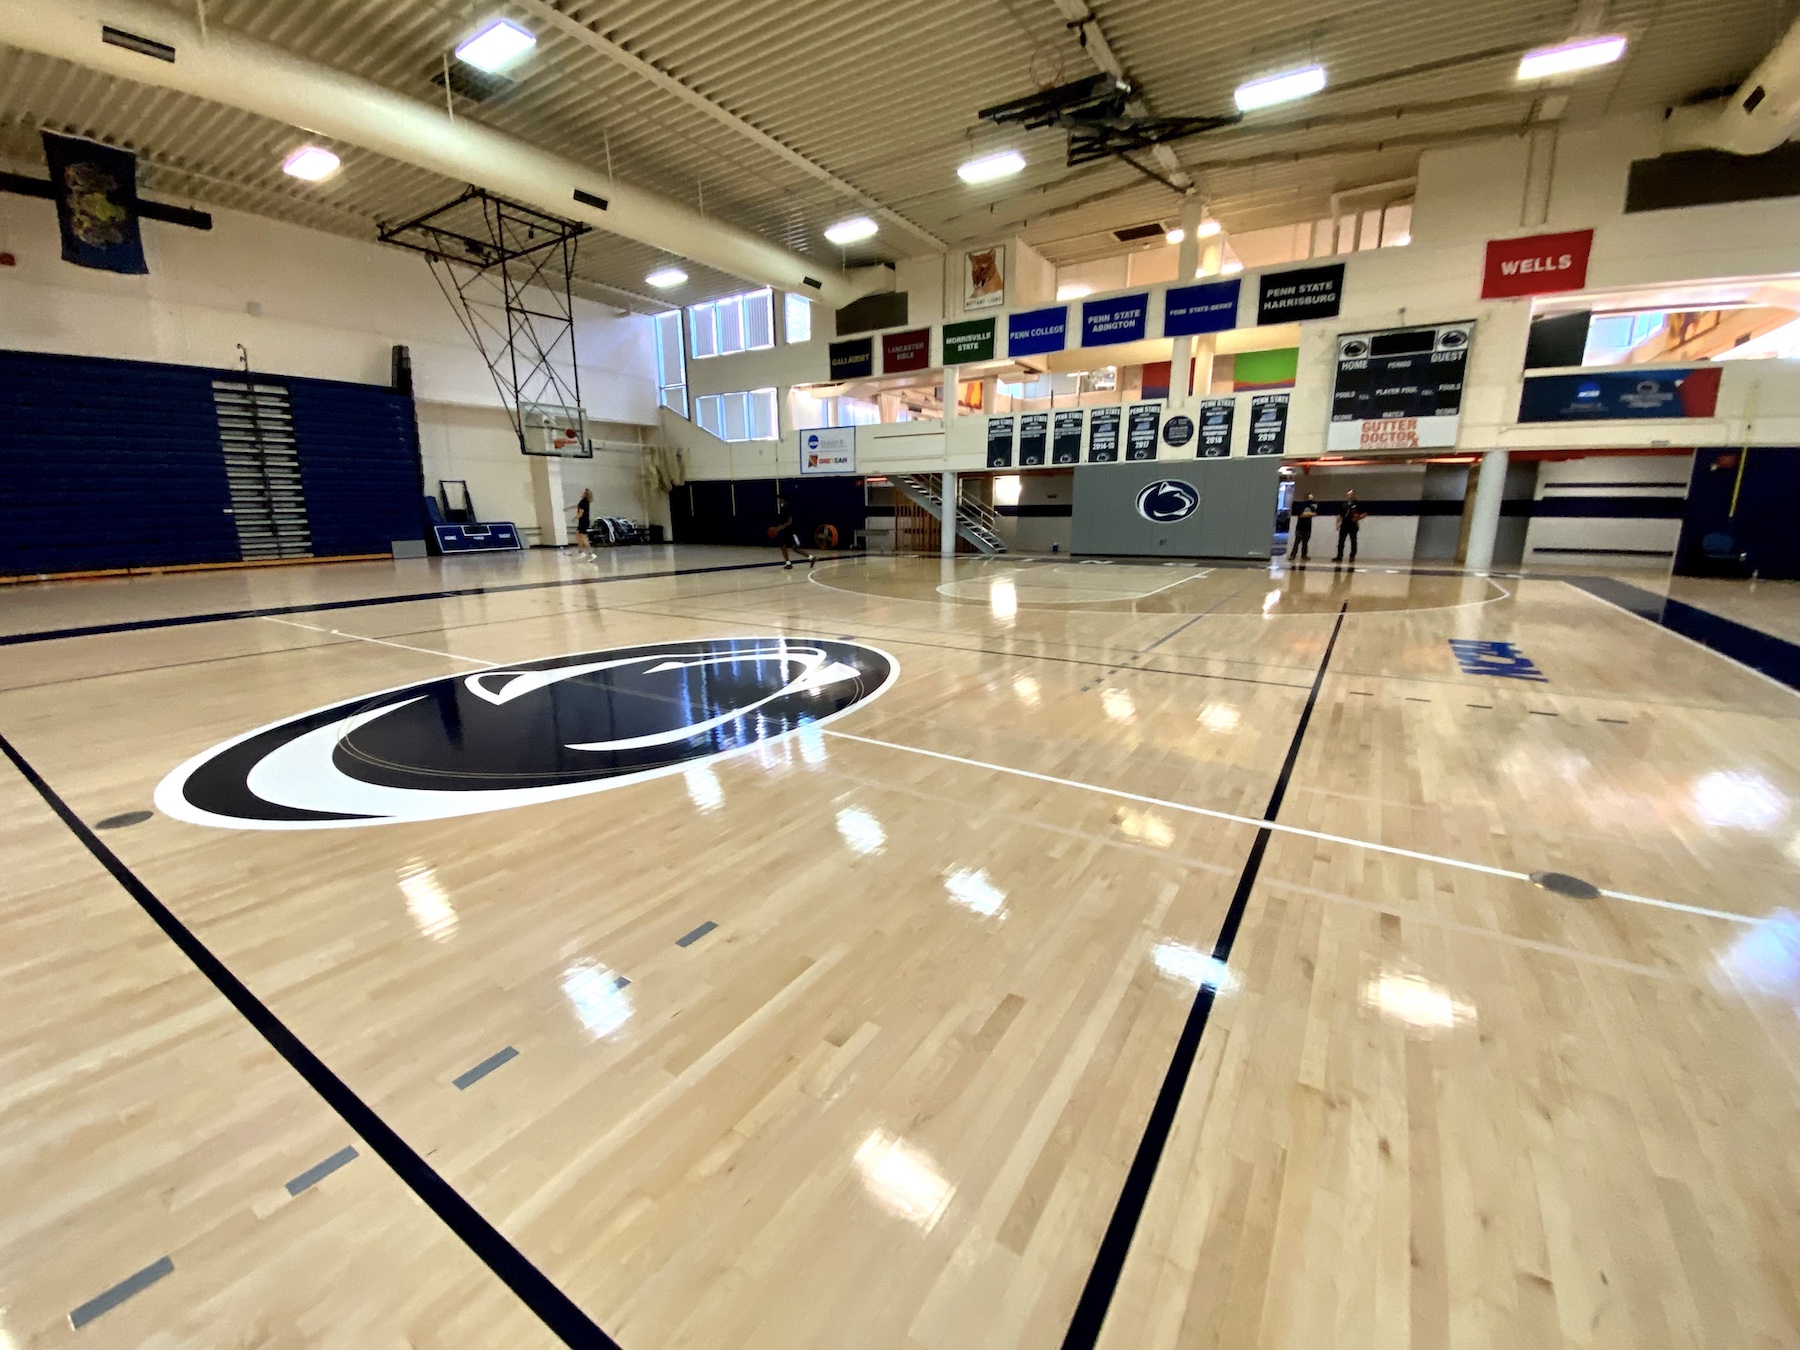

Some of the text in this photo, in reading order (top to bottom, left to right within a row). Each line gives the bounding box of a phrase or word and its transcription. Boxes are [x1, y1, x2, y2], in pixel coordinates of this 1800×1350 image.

[1501, 254, 1572, 276] WELLS
[1266, 281, 1333, 298] PENN STATE
[1264, 292, 1336, 310] HARRISBURG
[1088, 309, 1141, 325] PENN STATE
[1010, 324, 1064, 339] PENN COLLEGE
[1092, 320, 1136, 333] ABINGTON
[946, 332, 991, 345] MORRISVILLE
[958, 342, 979, 352] STATE
[1430, 351, 1463, 363] GUEST
[1341, 360, 1368, 371] HOME
[1361, 419, 1417, 432] GUTTER
